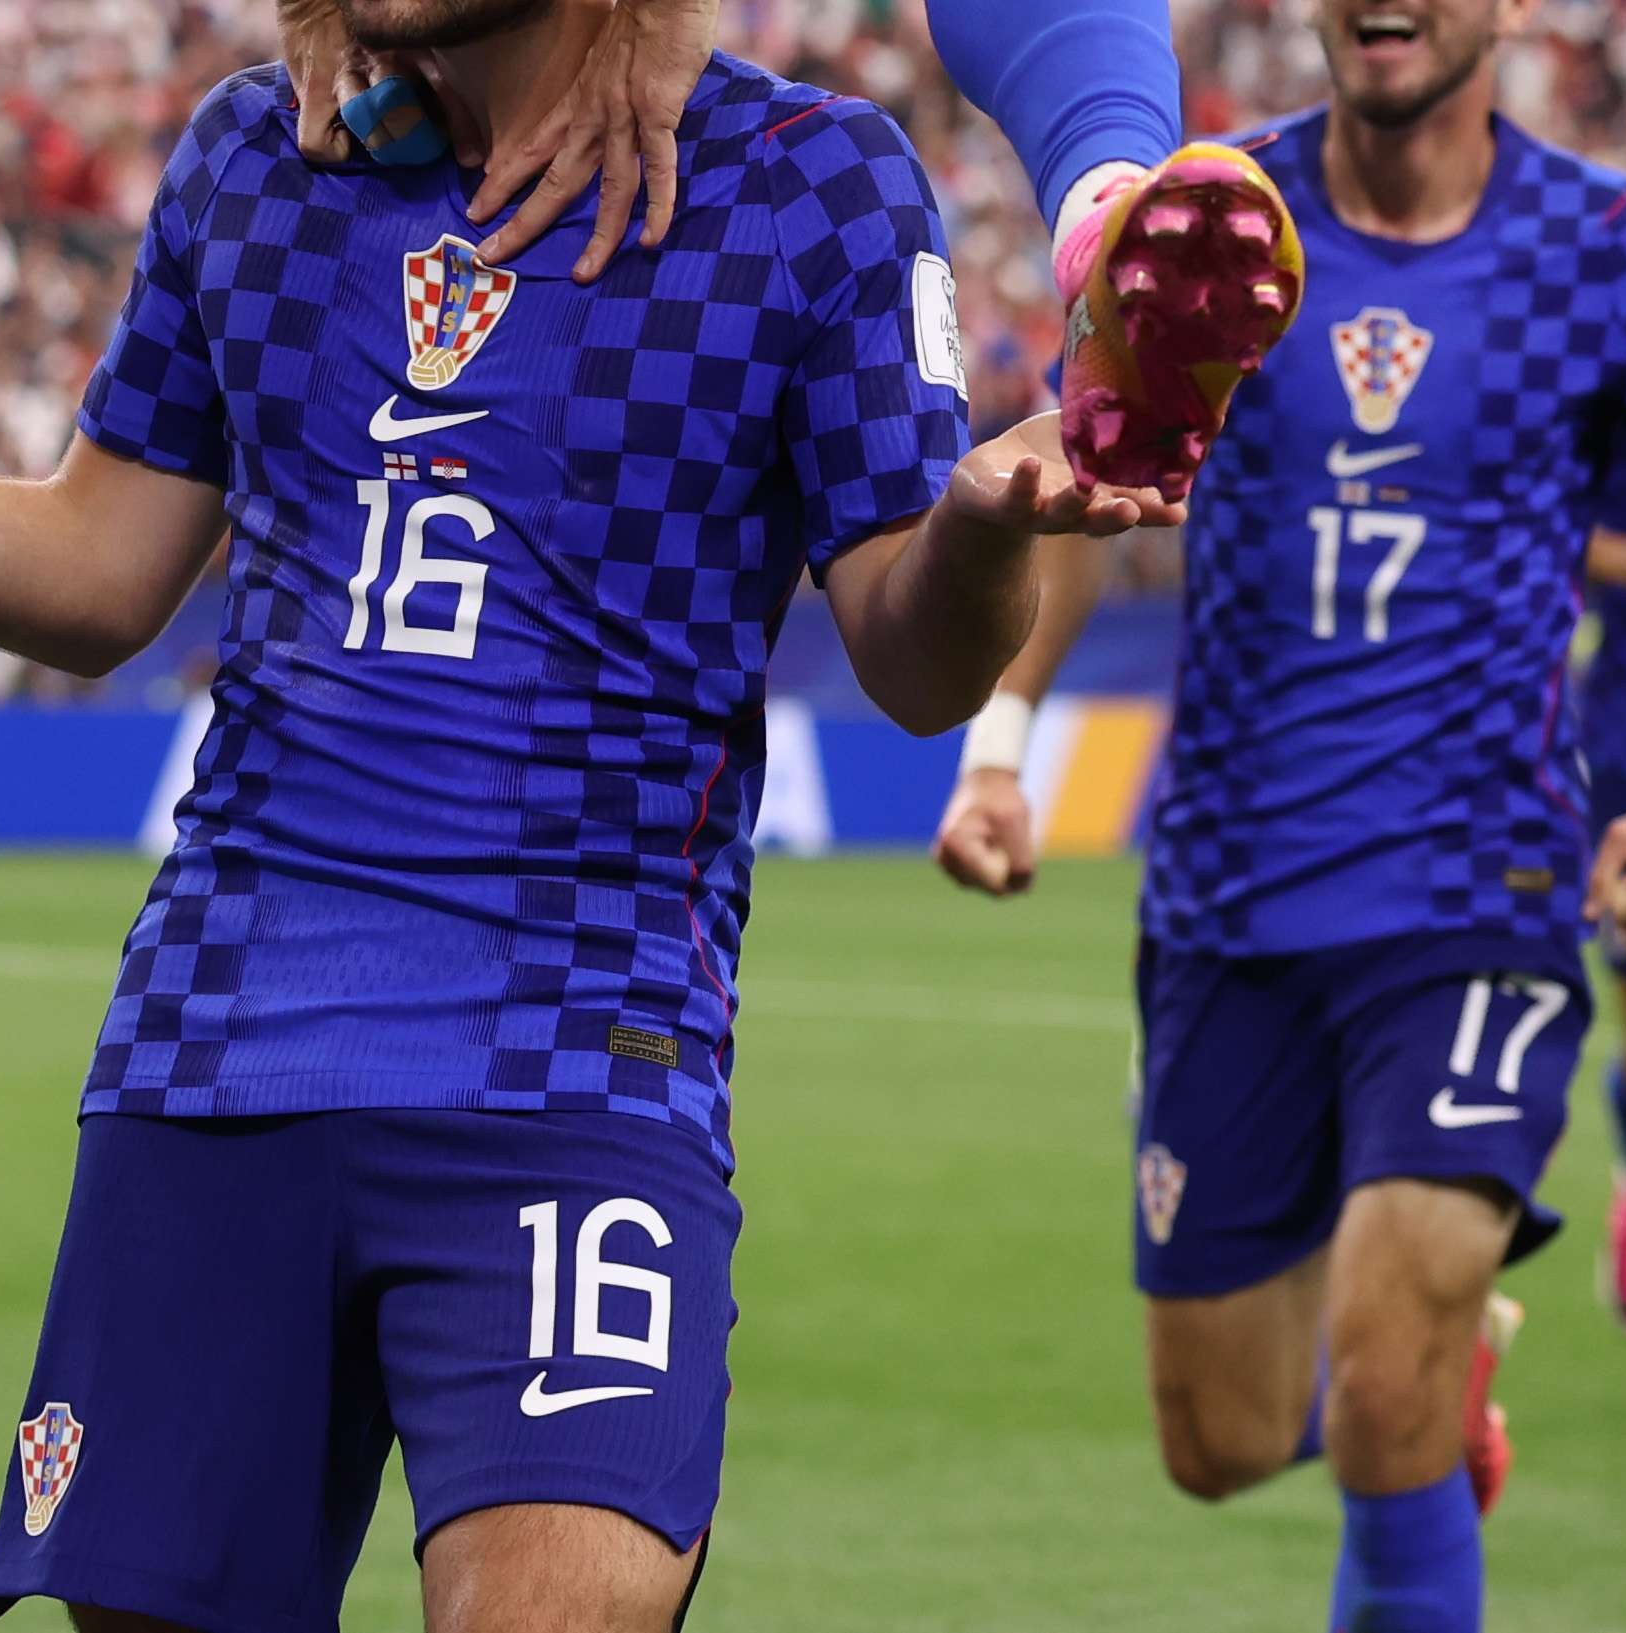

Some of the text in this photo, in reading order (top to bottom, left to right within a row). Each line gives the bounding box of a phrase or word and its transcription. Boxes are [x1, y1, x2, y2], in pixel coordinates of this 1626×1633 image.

[343, 478, 497, 660] 16
[1308, 508, 1427, 643] 17
[1448, 975, 1571, 1095] 17
[519, 1197, 674, 1373] 16
